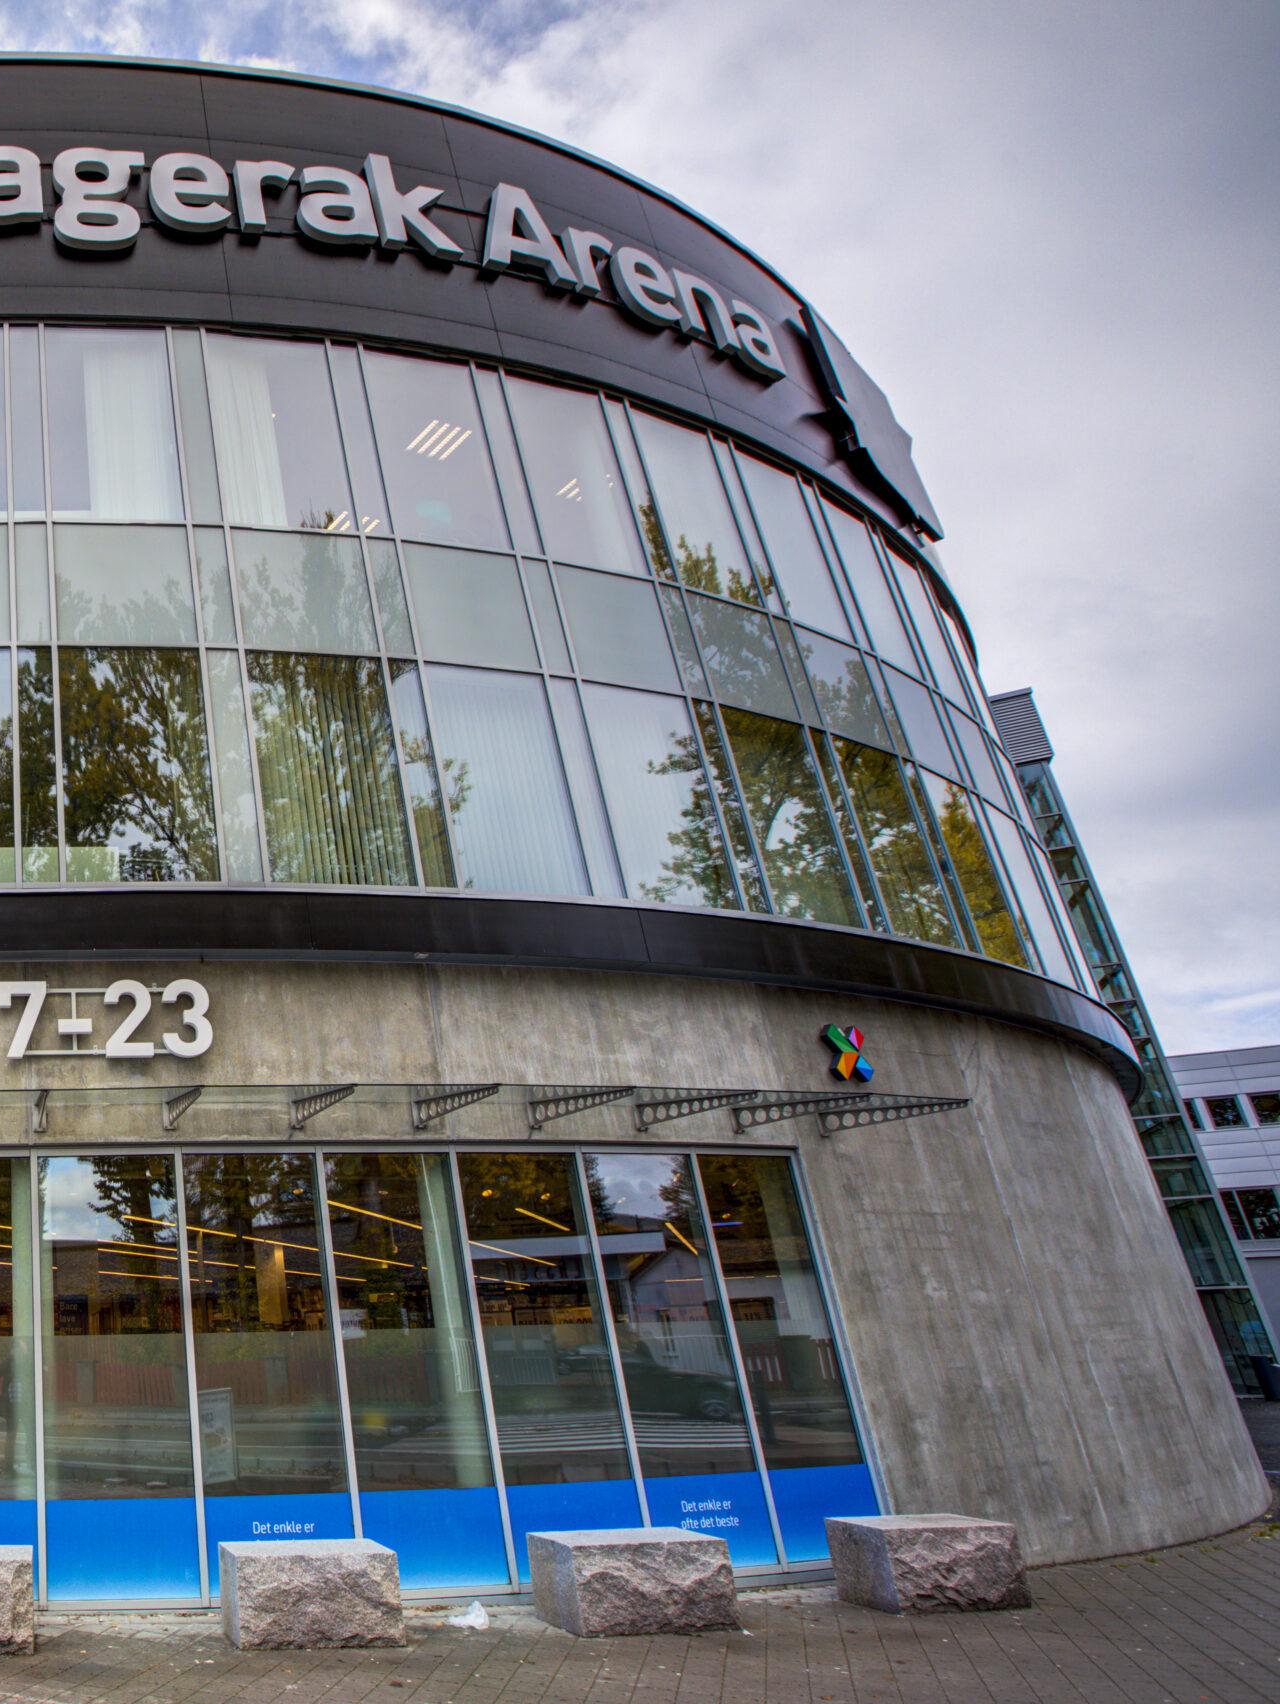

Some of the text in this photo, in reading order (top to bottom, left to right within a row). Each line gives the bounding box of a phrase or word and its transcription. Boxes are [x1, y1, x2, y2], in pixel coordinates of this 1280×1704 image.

[482, 182, 788, 382] Arena
[681, 1500, 731, 1512] Det enkle er
[252, 1521, 315, 1534] Det enkle er
[681, 1516, 740, 1530] ofte det beste
